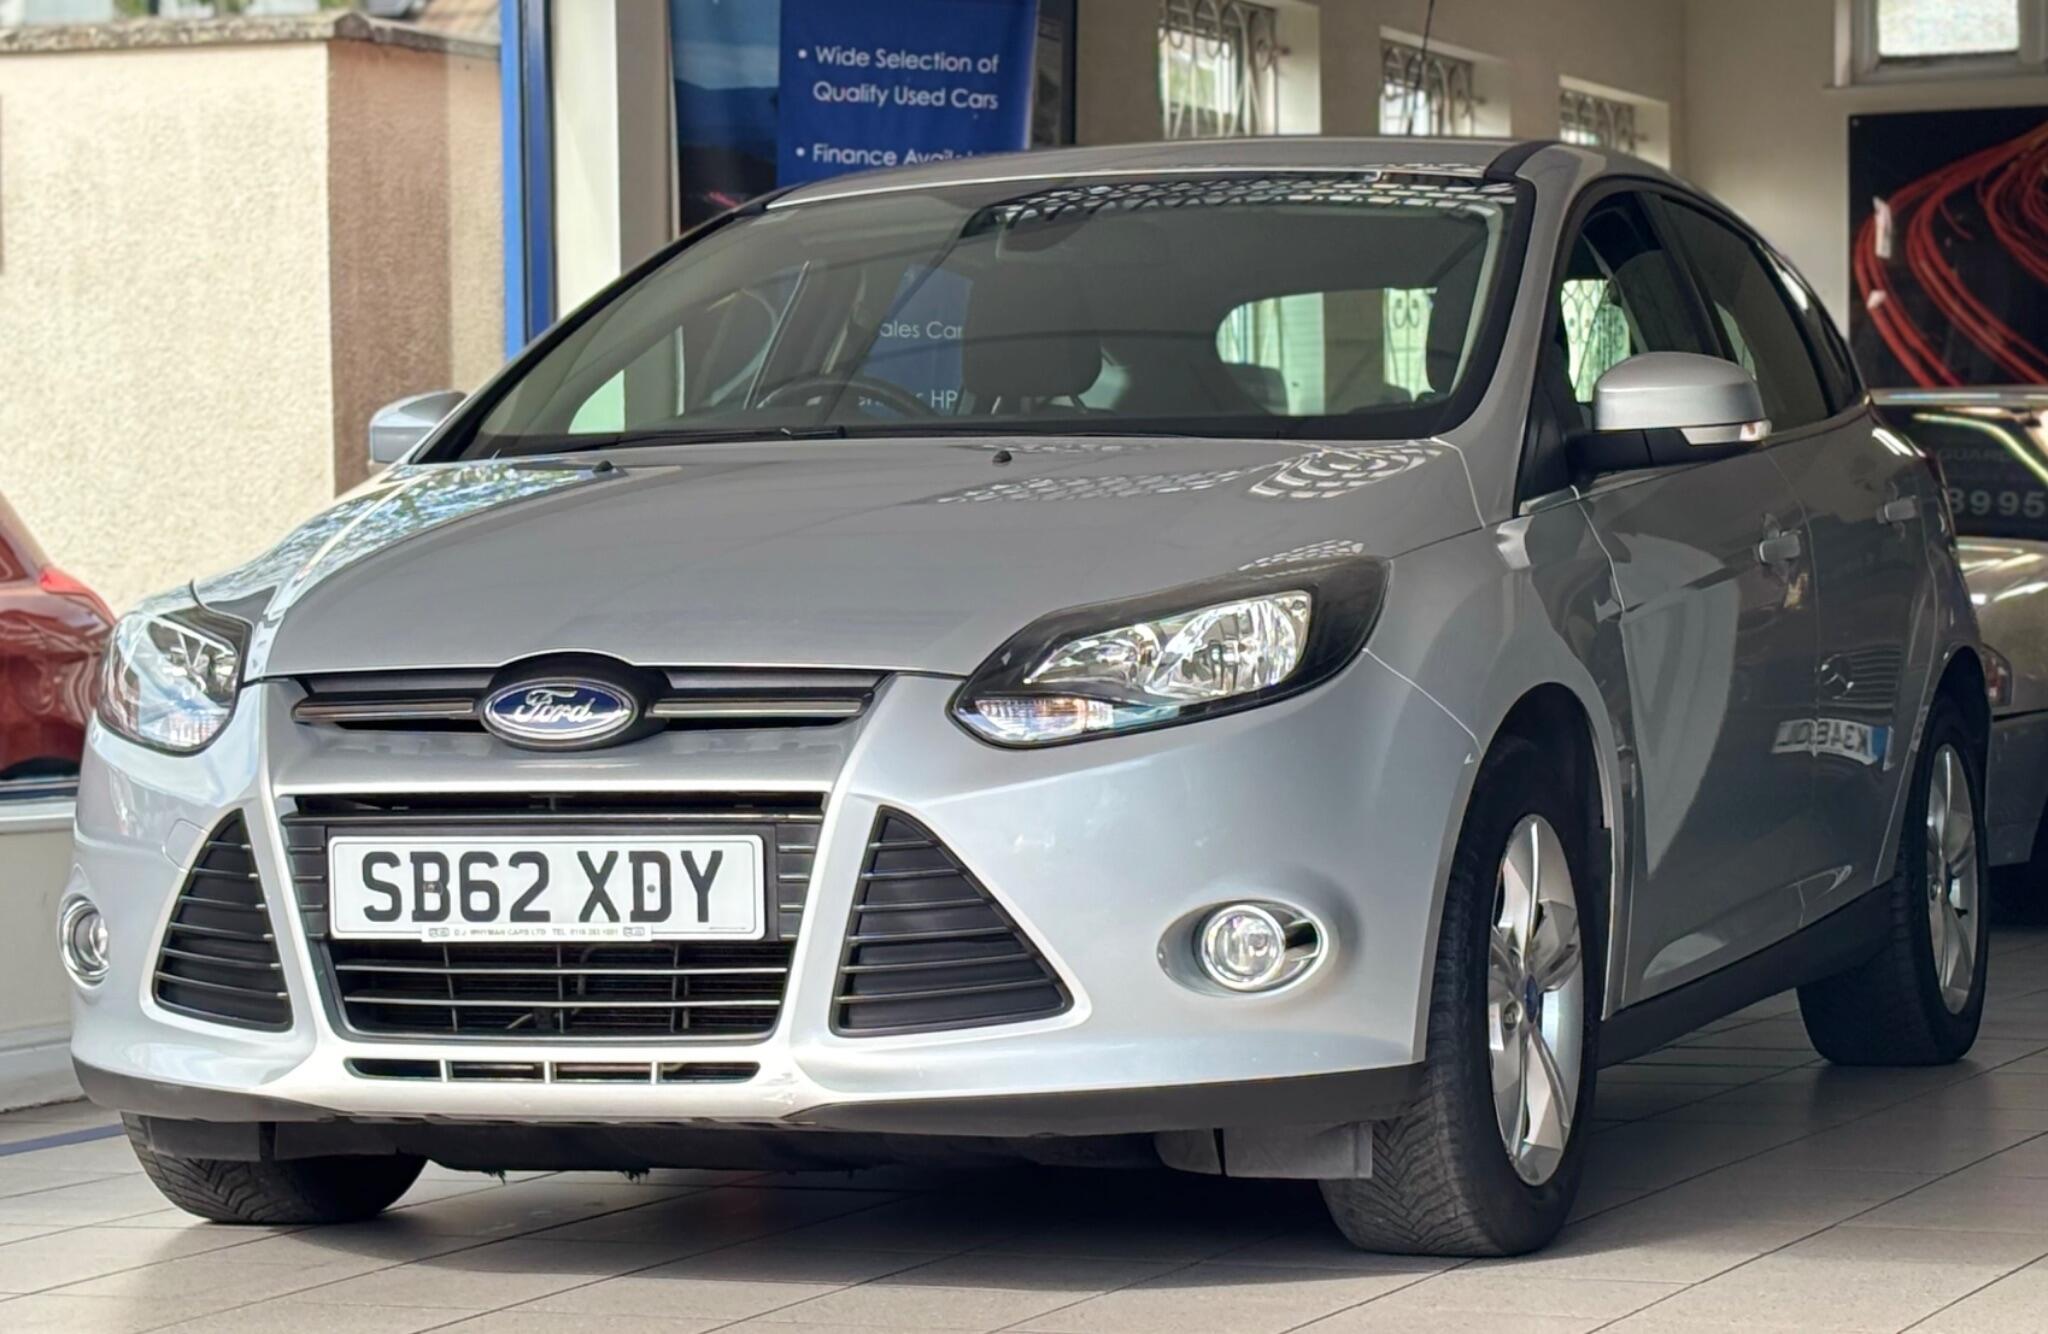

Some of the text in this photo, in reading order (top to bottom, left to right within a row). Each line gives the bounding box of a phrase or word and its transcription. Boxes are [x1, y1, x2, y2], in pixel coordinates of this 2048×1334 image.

[815, 46, 999, 73] Wide Selection of
[813, 81, 999, 110] Quality Used Cars
[813, 144, 897, 167] Finance
[879, 320, 920, 338] ales
[512, 688, 596, 723] Ford
[362, 851, 723, 922] SB62 XDY
